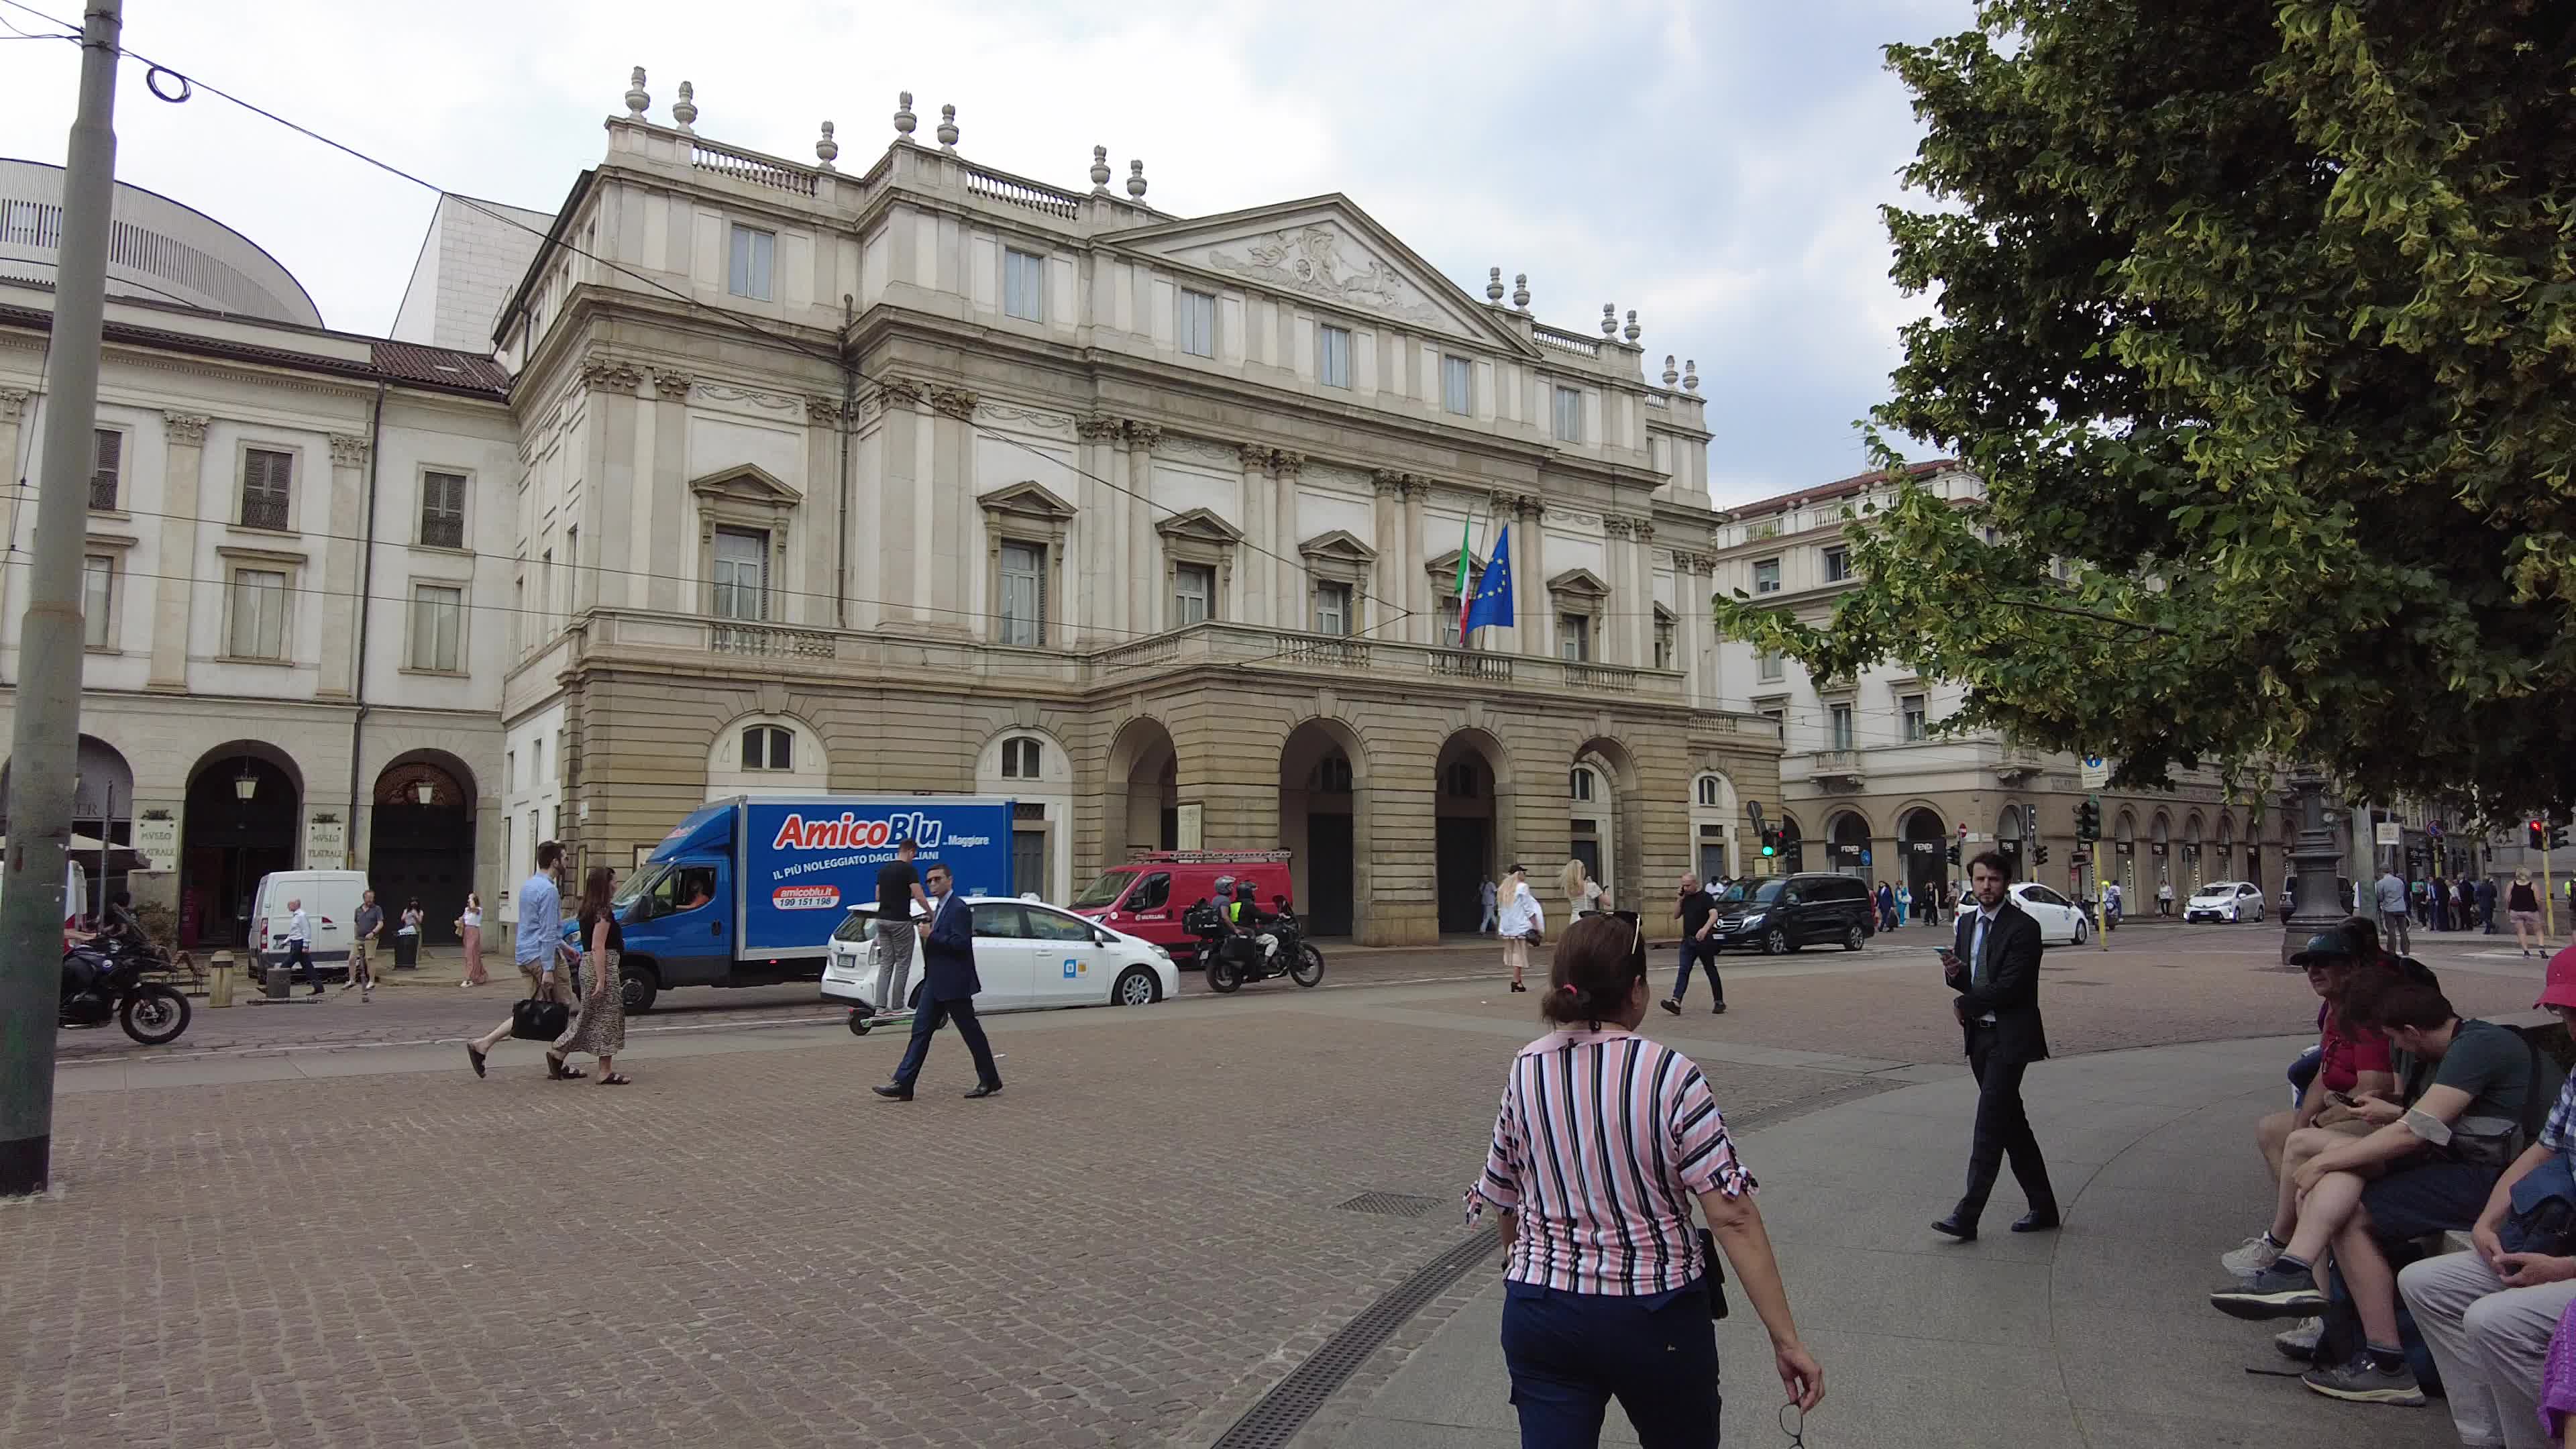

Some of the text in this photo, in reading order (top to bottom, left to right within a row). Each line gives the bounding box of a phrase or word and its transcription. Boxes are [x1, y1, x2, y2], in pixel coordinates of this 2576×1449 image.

[773, 812, 942, 849] AmicoBlu
[773, 870, 784, 880] IL
[784, 863, 802, 877] PIÙ
[803, 855, 867, 873] NOLEGGIATO
[780, 887, 832, 898] amicoblu.it
[780, 897, 832, 907] 199 151 198
